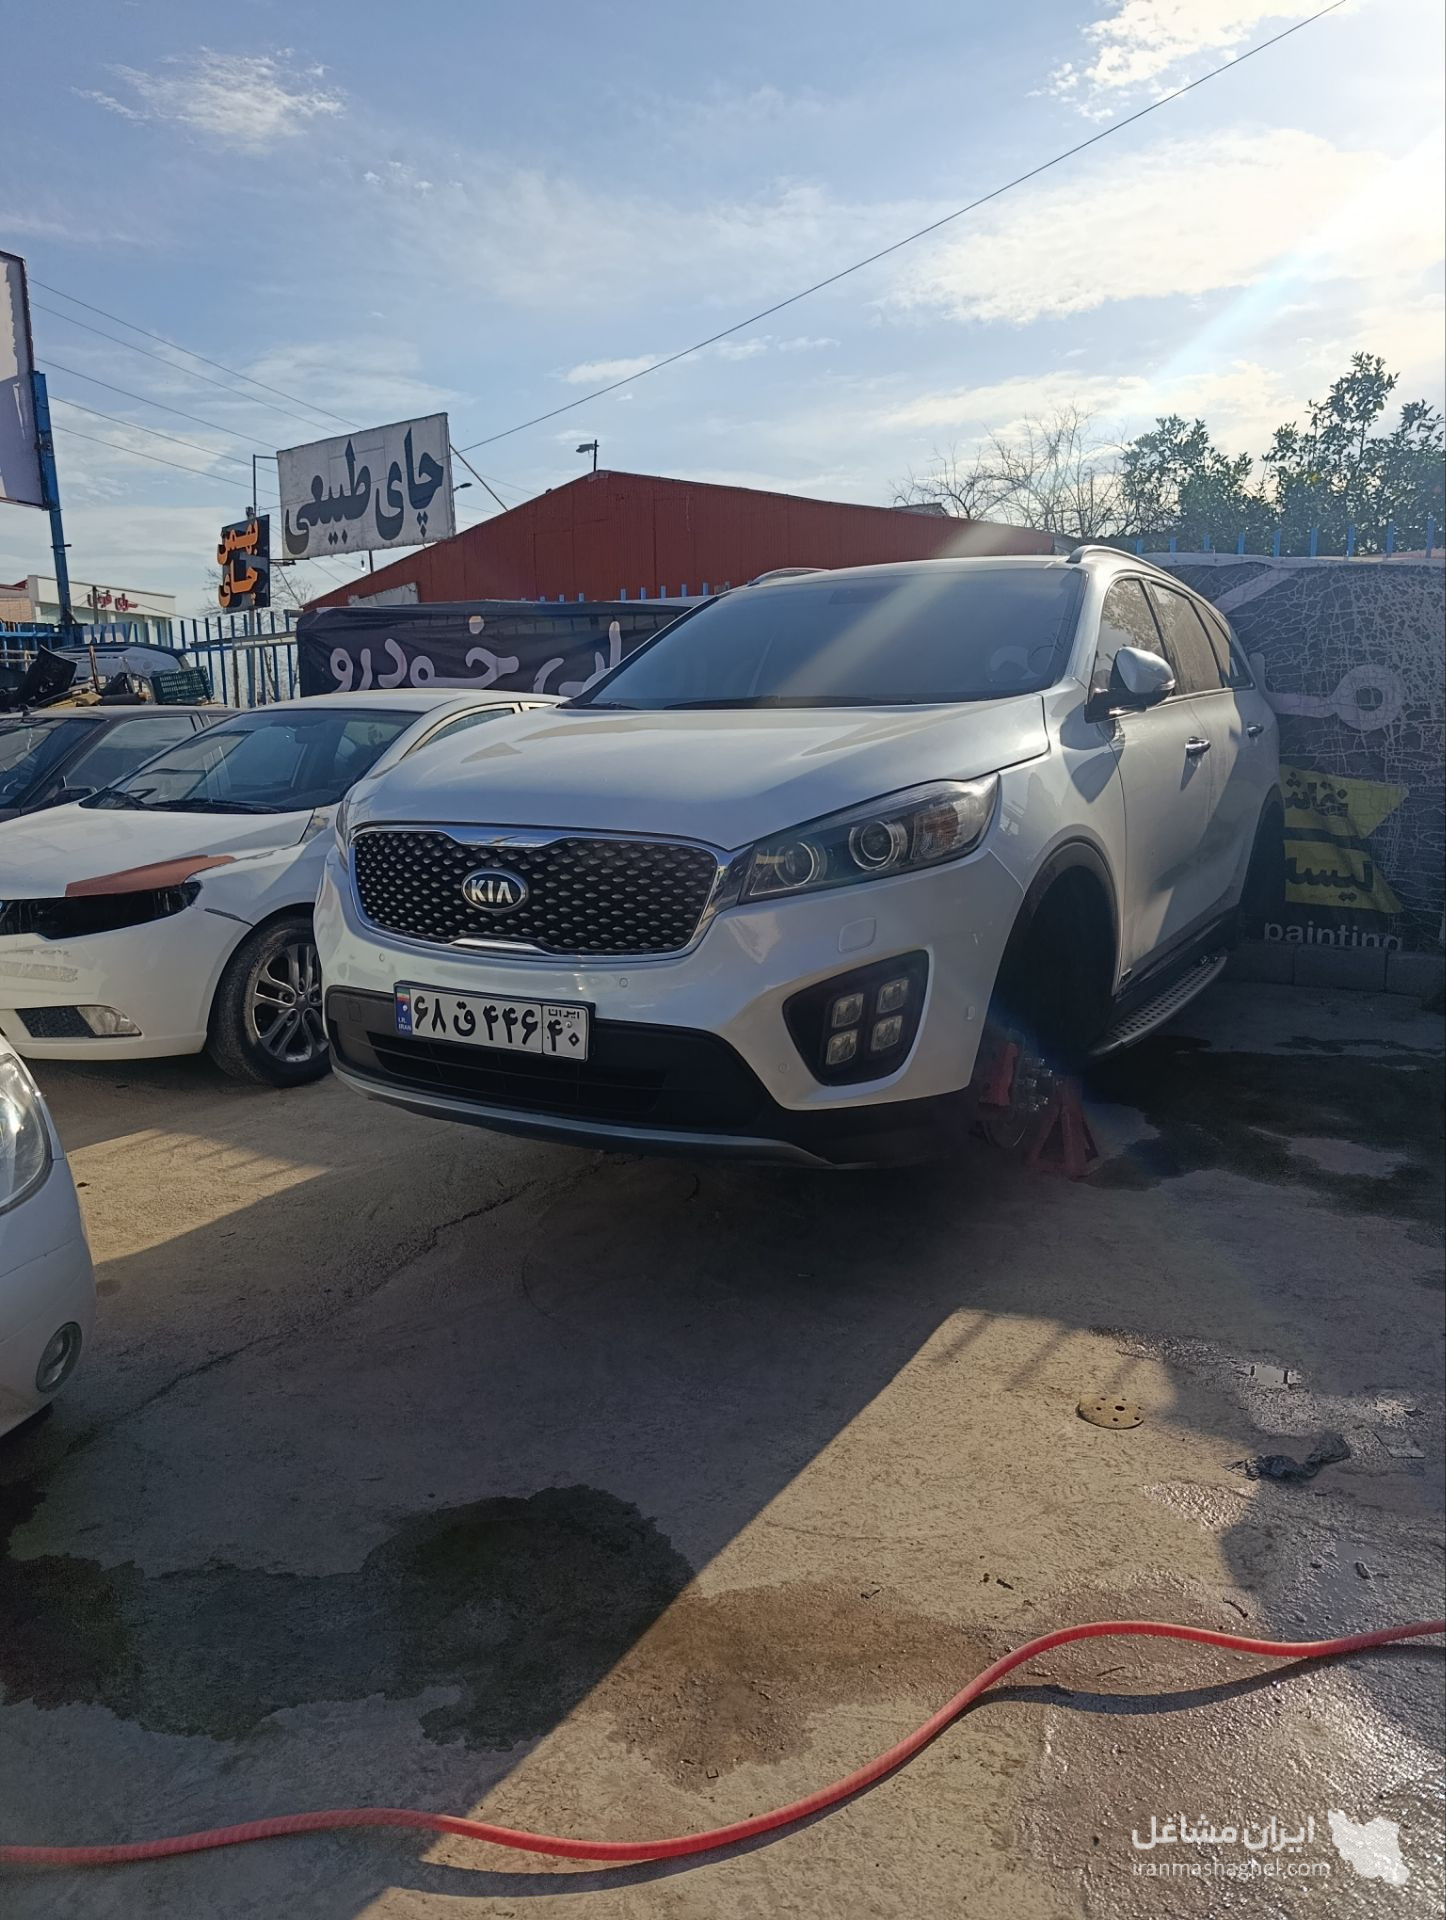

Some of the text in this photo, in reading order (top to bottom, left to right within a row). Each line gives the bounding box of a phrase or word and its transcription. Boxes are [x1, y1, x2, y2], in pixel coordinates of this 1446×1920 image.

[285, 427, 444, 555] چای طبیعی
[330, 615, 519, 692] خودرو
[471, 879, 515, 905] KIA
